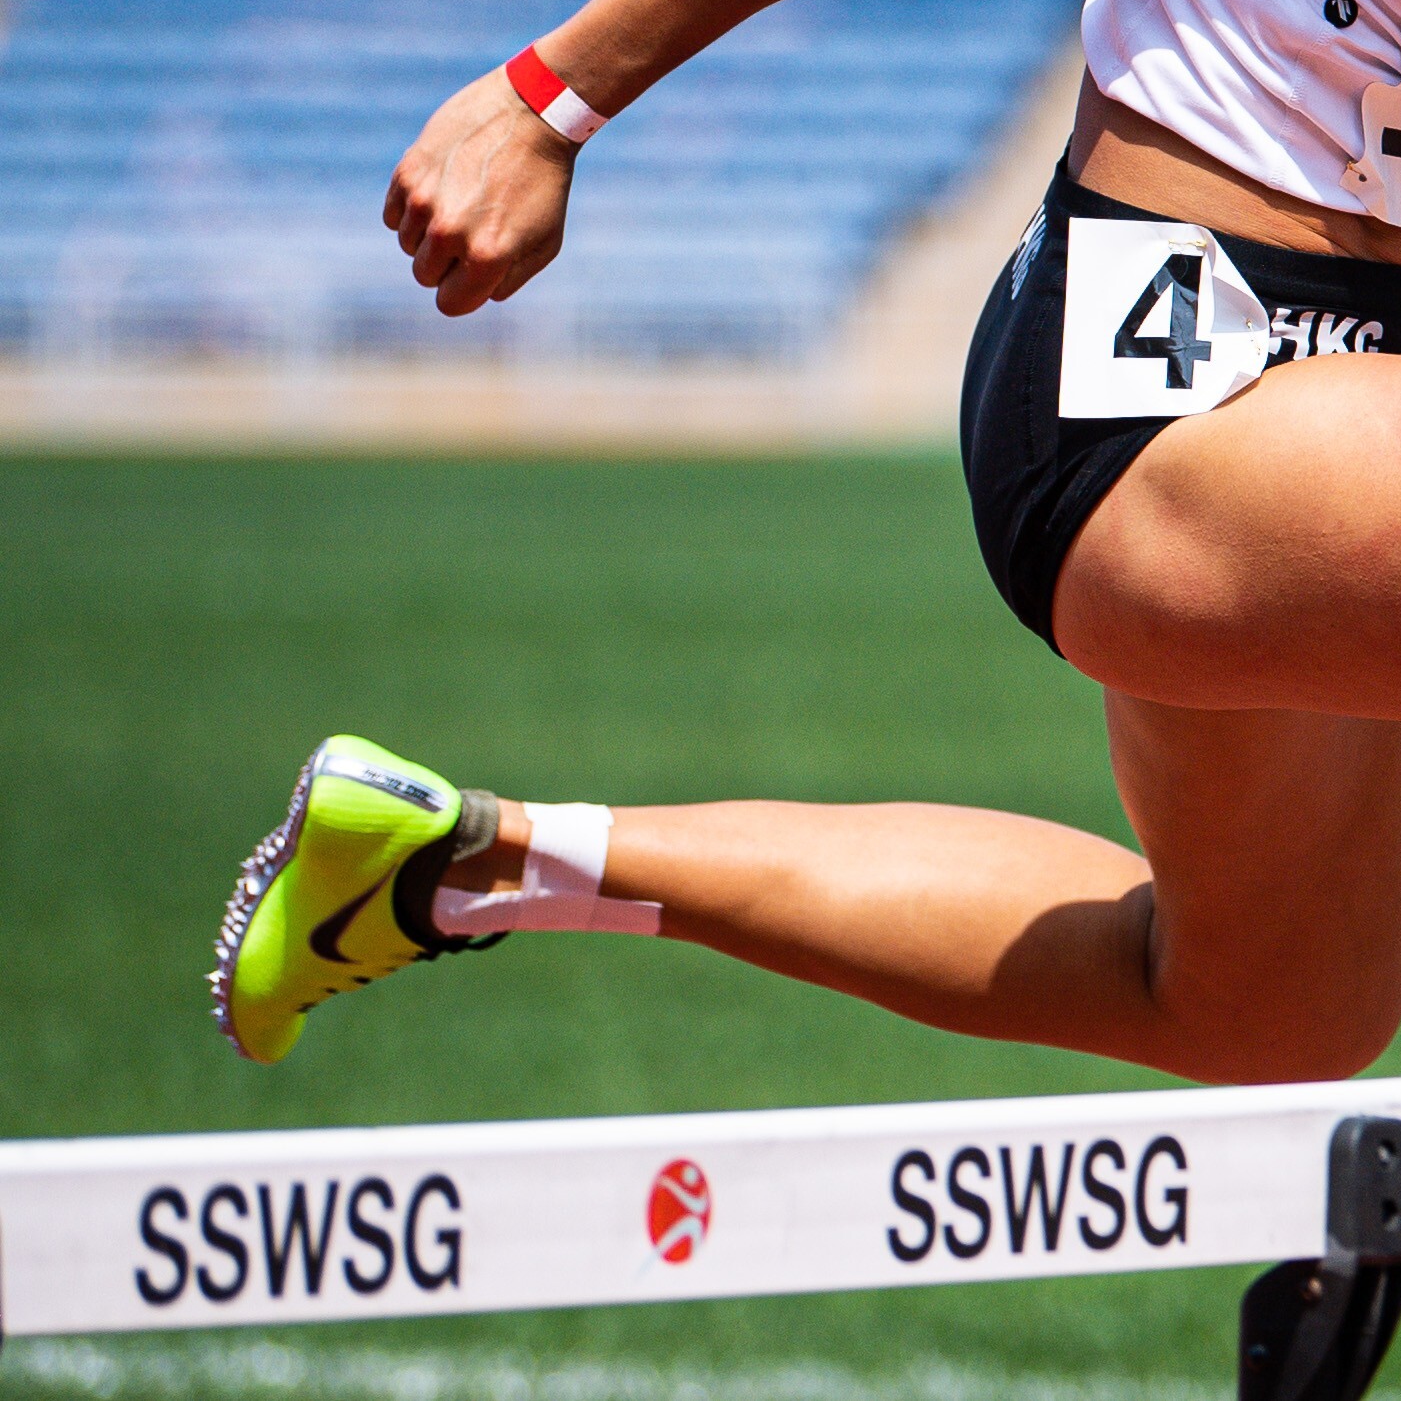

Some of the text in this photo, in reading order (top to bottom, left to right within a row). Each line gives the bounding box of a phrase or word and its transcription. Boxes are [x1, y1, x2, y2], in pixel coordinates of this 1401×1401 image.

[1112, 252, 1212, 390] 4
[135, 1174, 461, 1306] SSWSG
[888, 1136, 1188, 1263] SSWSG
